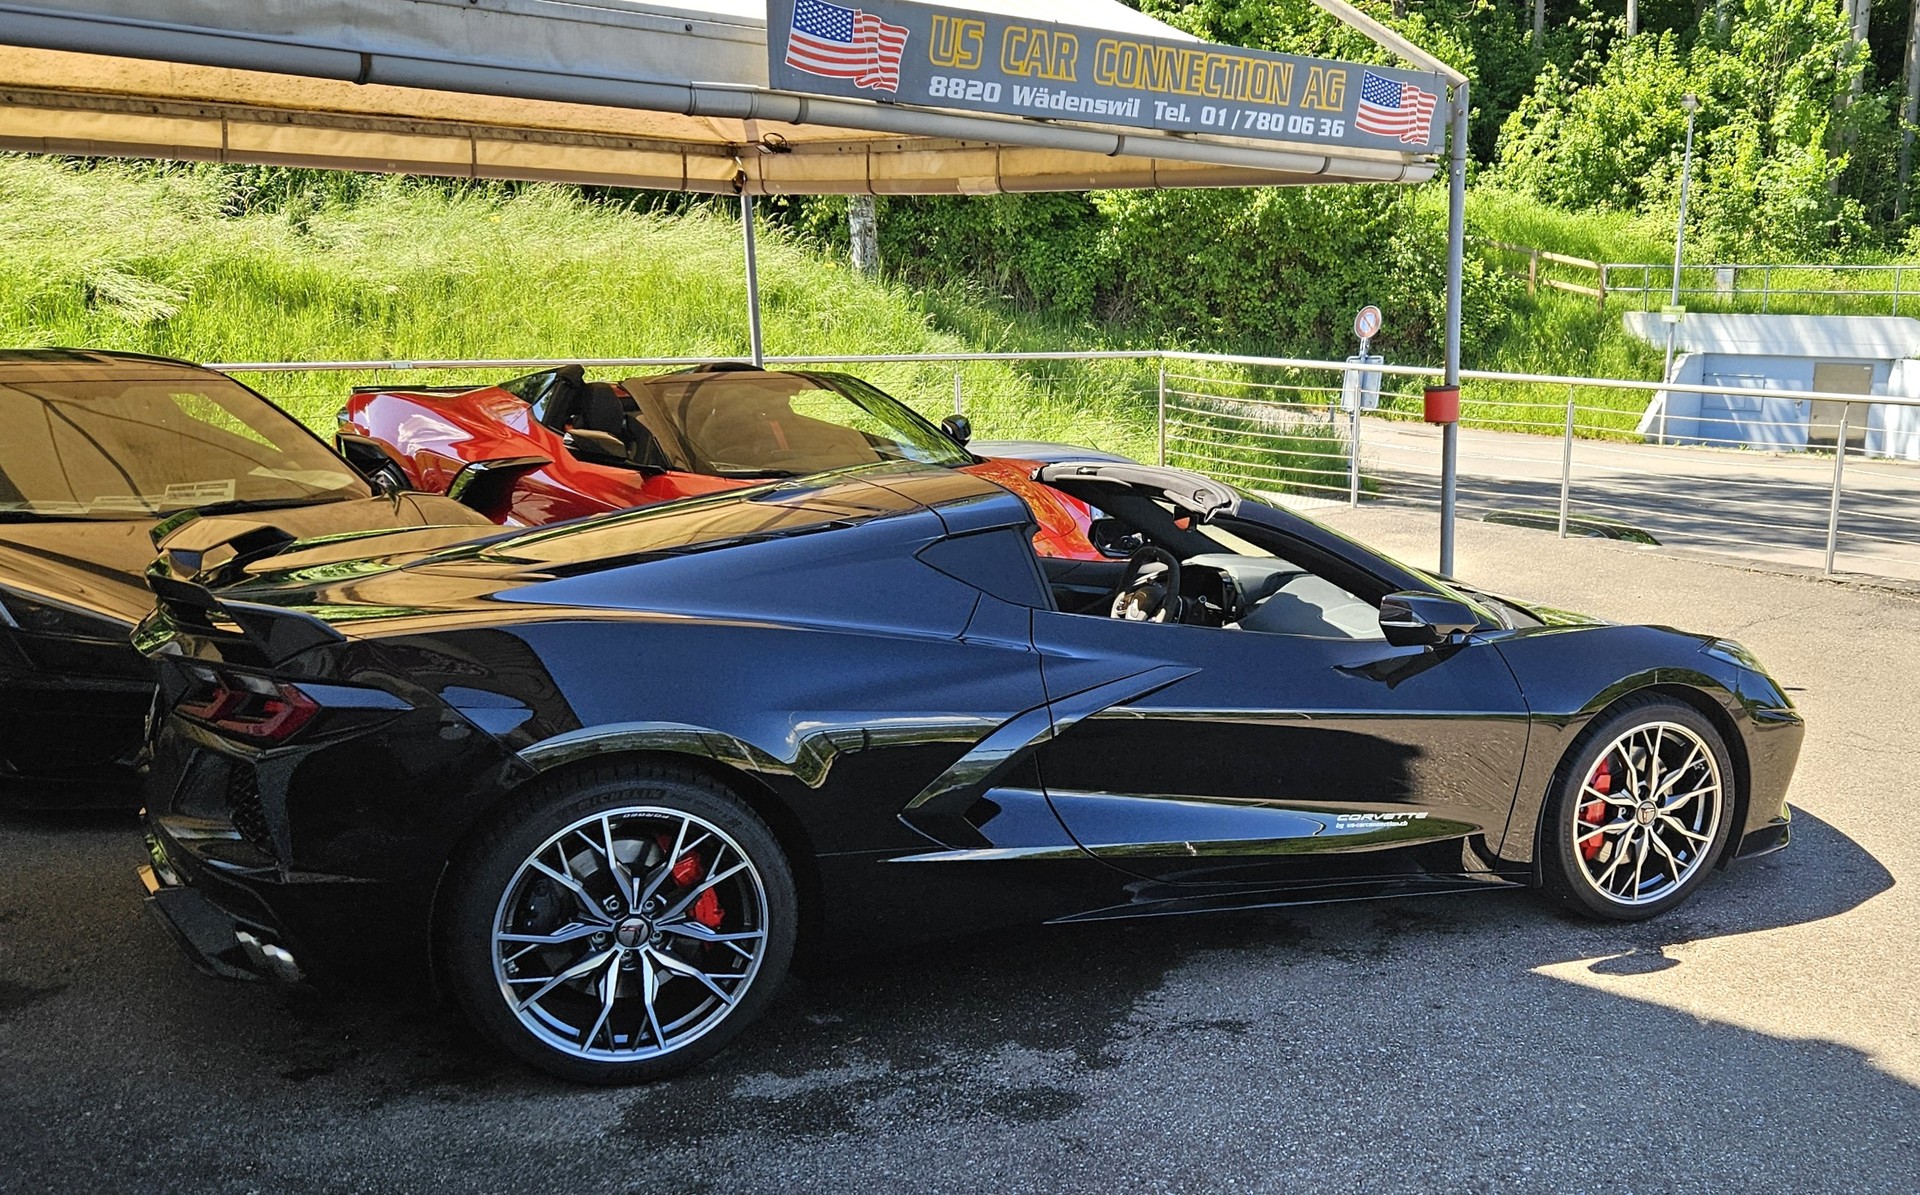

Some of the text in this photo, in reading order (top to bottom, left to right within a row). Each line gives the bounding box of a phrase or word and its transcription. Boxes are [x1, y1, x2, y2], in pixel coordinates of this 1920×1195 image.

[929, 14, 1347, 112] US CAR CONNECTION AG
[928, 75, 1002, 103] 8820
[1012, 84, 1141, 118] Wädenswil
[1154, 100, 1191, 123] Tel.
[1287, 114, 1315, 135] 06
[1317, 118, 1346, 138] 36
[1337, 812, 1429, 821] CORVETTE
